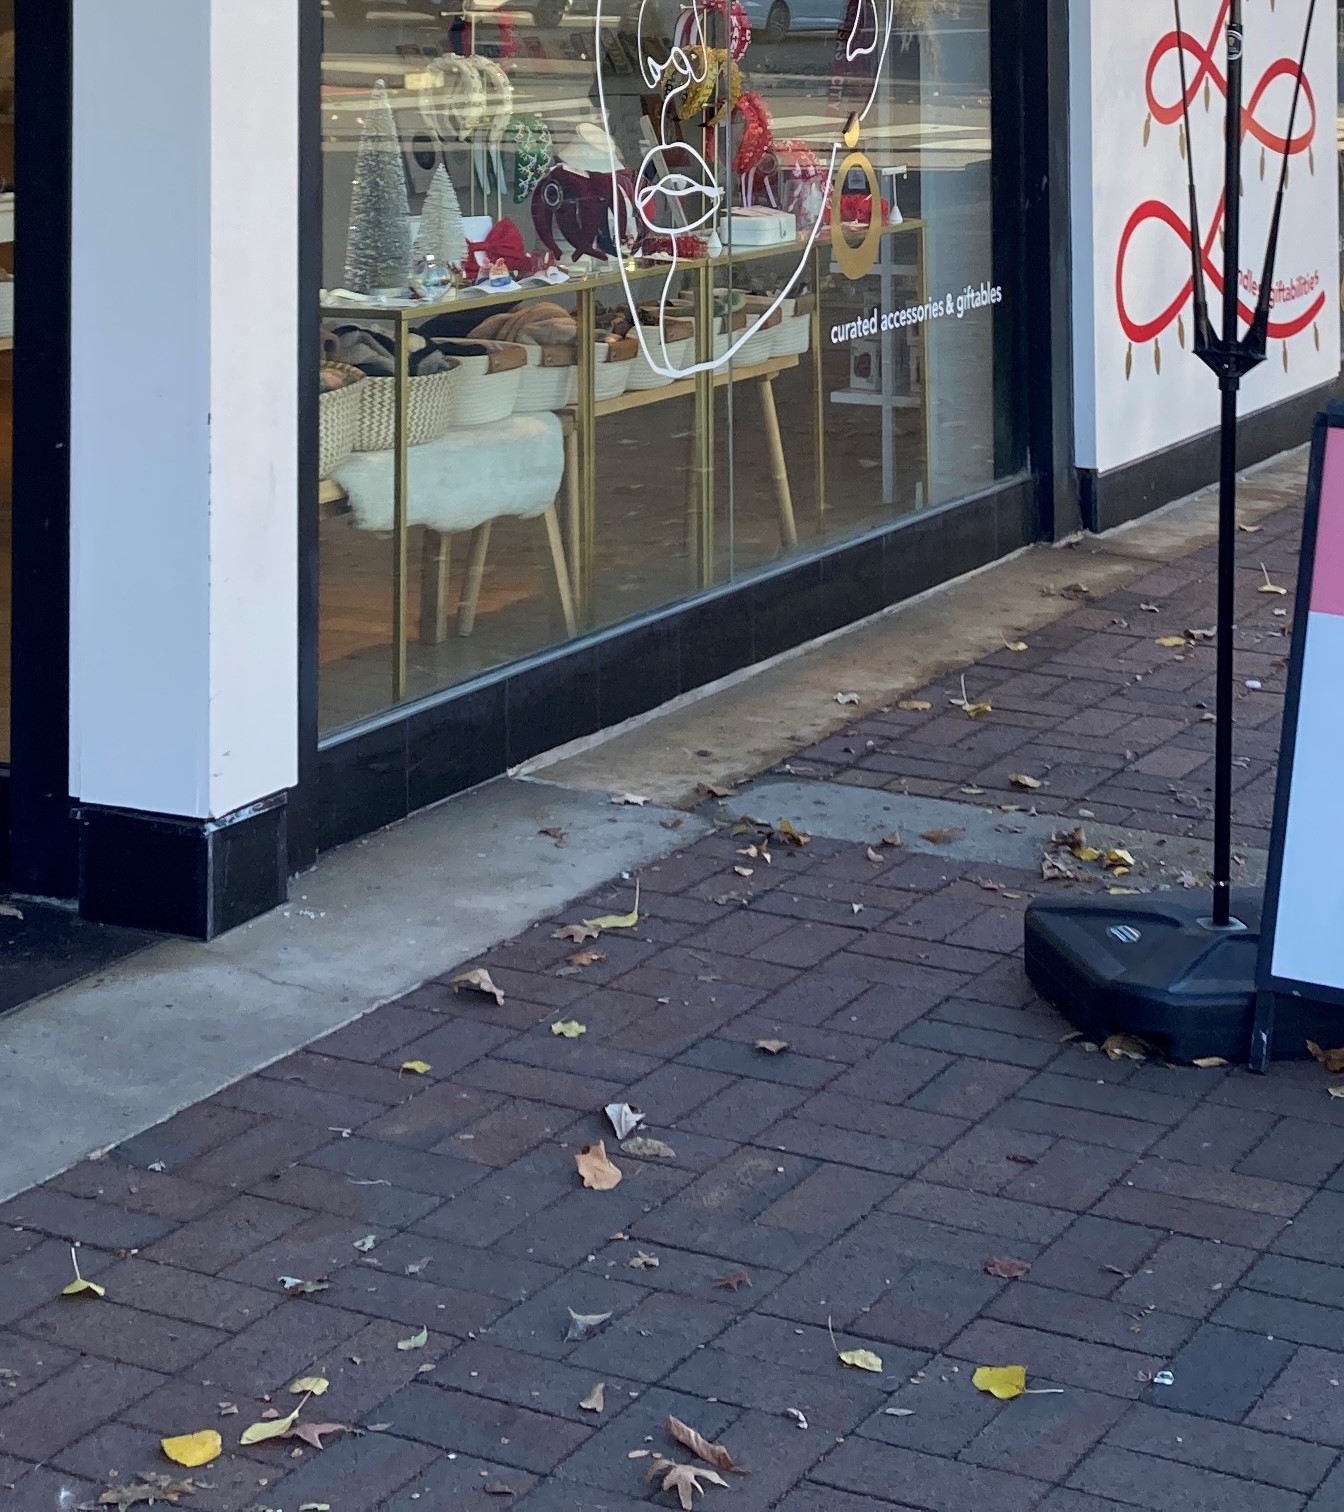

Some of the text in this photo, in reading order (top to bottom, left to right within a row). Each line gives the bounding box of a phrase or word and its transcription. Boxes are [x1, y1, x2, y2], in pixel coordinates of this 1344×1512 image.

[830, 281, 1002, 344] curated accessories & giftables
